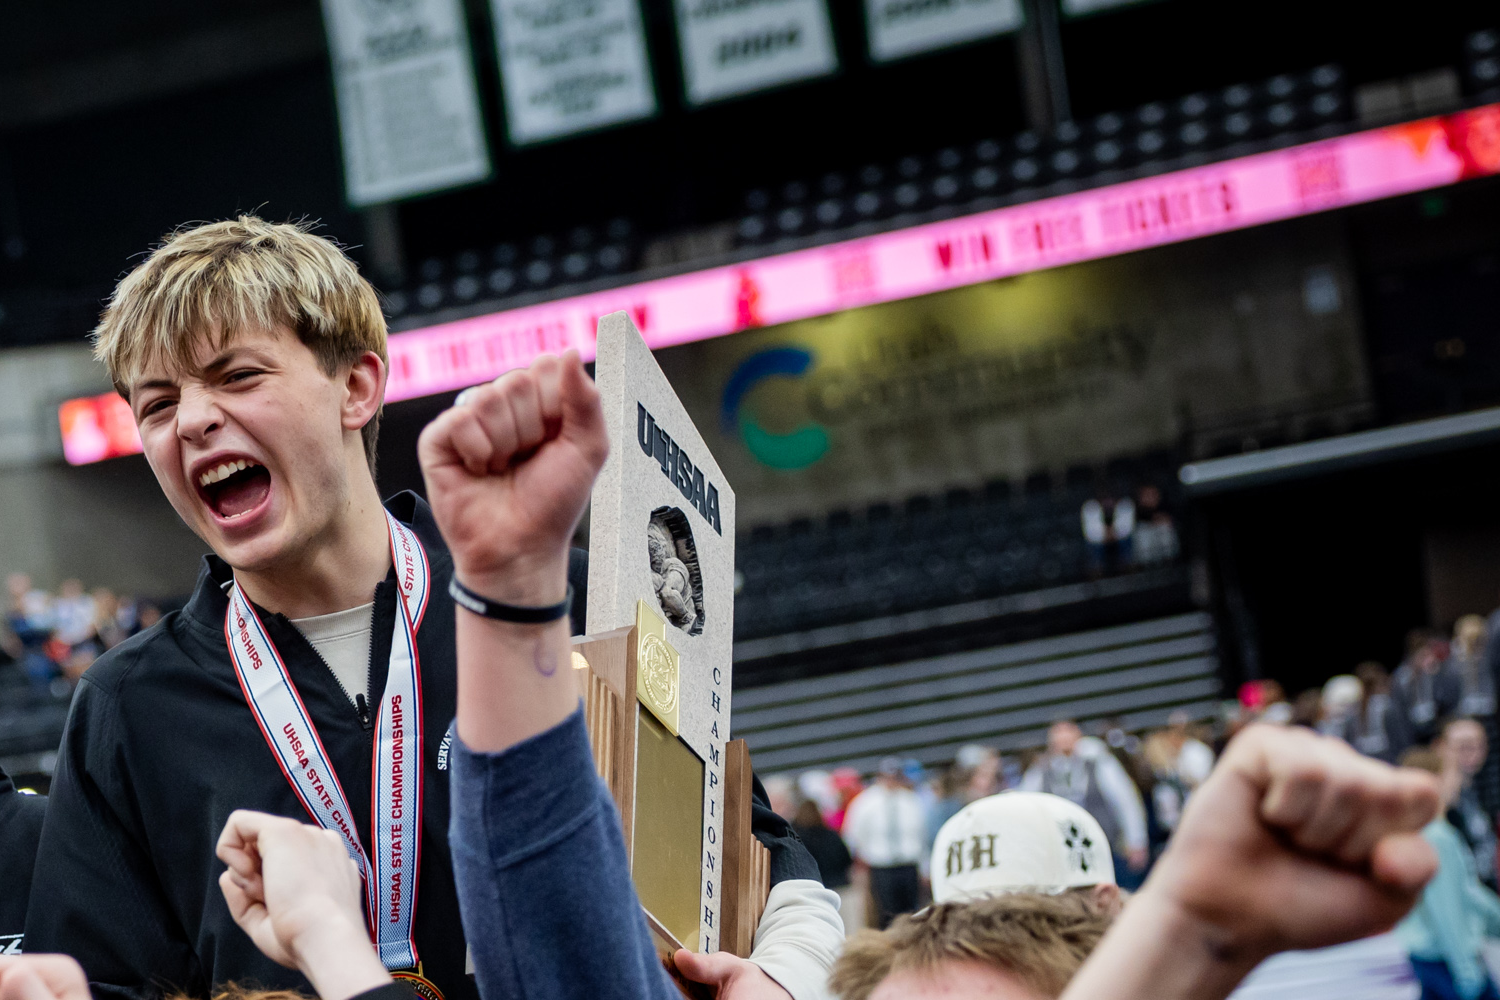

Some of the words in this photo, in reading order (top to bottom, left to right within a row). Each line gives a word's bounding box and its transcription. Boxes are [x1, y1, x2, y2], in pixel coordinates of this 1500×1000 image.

[283, 722, 310, 769] UHSAA
[306, 768, 336, 810] STATE
[391, 694, 404, 820] CHAMPIONSHIPS
[437, 729, 452, 770] SERVAT
[703, 667, 721, 954] CHAMPIONSHI
[391, 823, 403, 869] STATE
[390, 873, 403, 923] UHSAA
